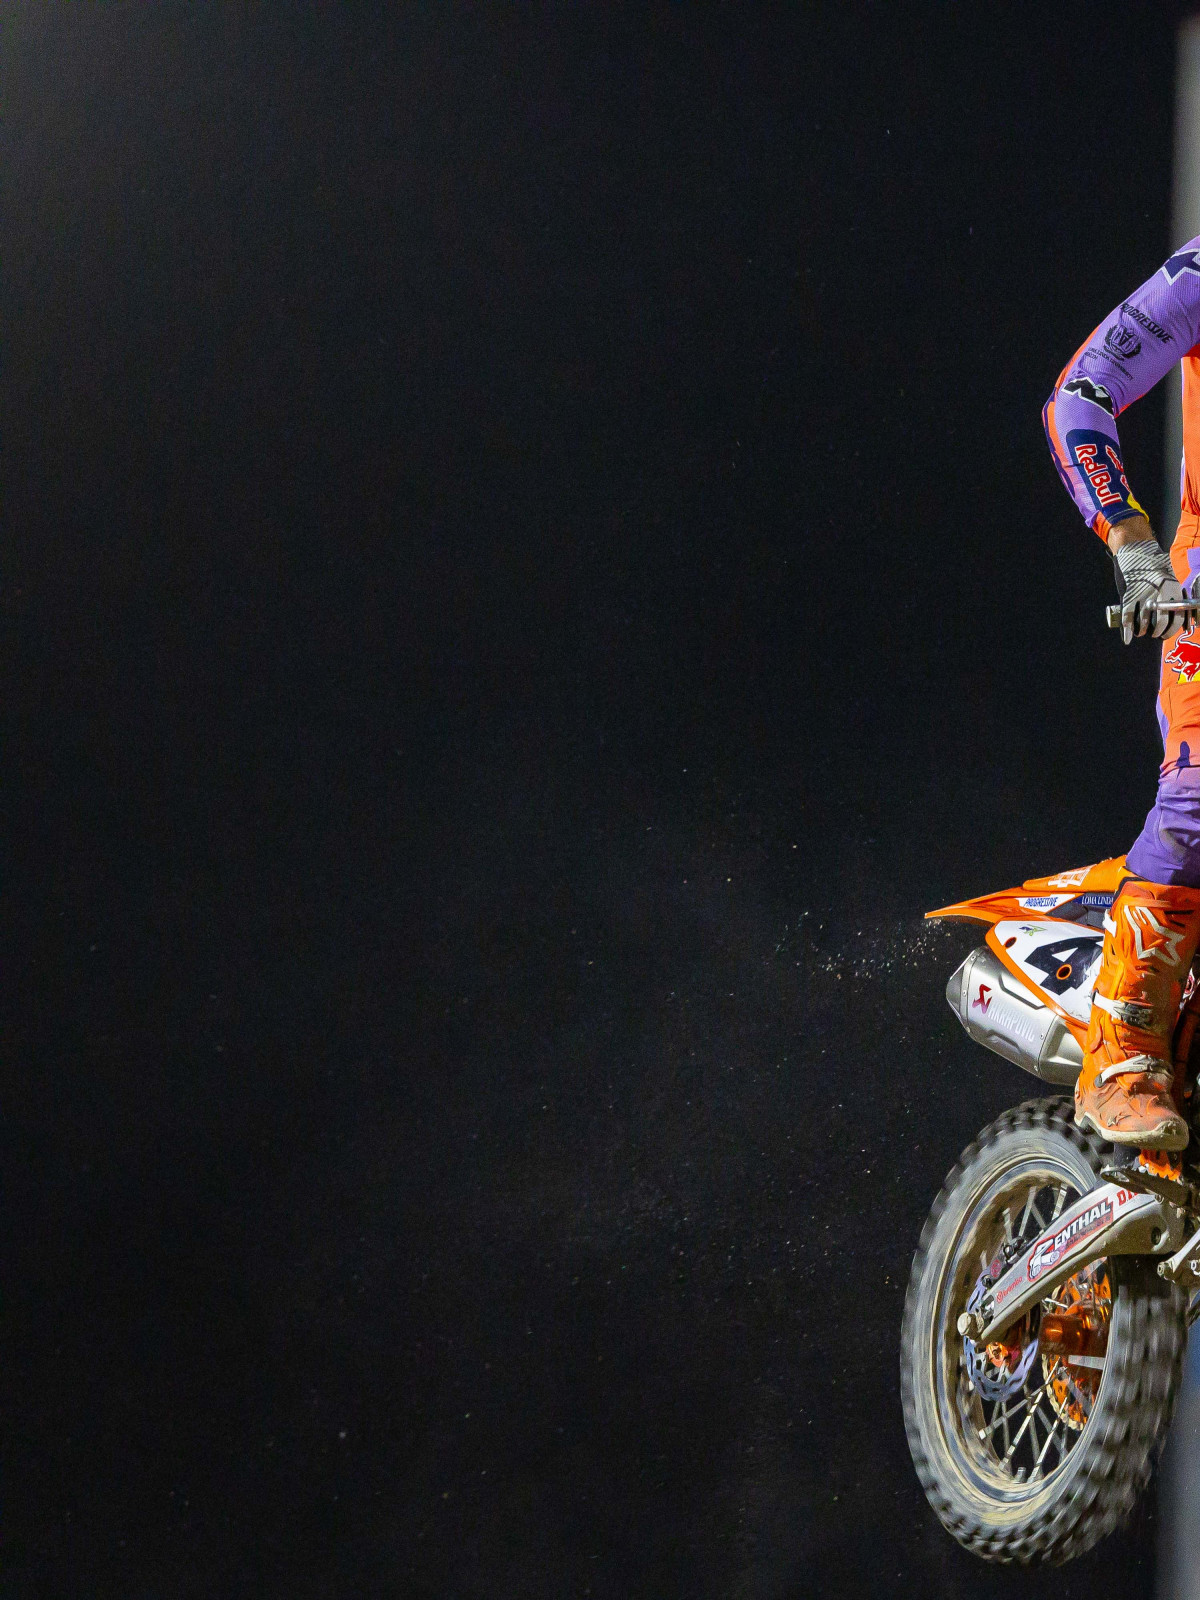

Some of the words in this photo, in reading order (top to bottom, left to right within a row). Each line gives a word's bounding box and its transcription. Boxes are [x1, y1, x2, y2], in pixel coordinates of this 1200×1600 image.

[1074, 443, 1108, 476] Red
[1089, 470, 1124, 508] Bull
[1024, 935, 1104, 996] 4
